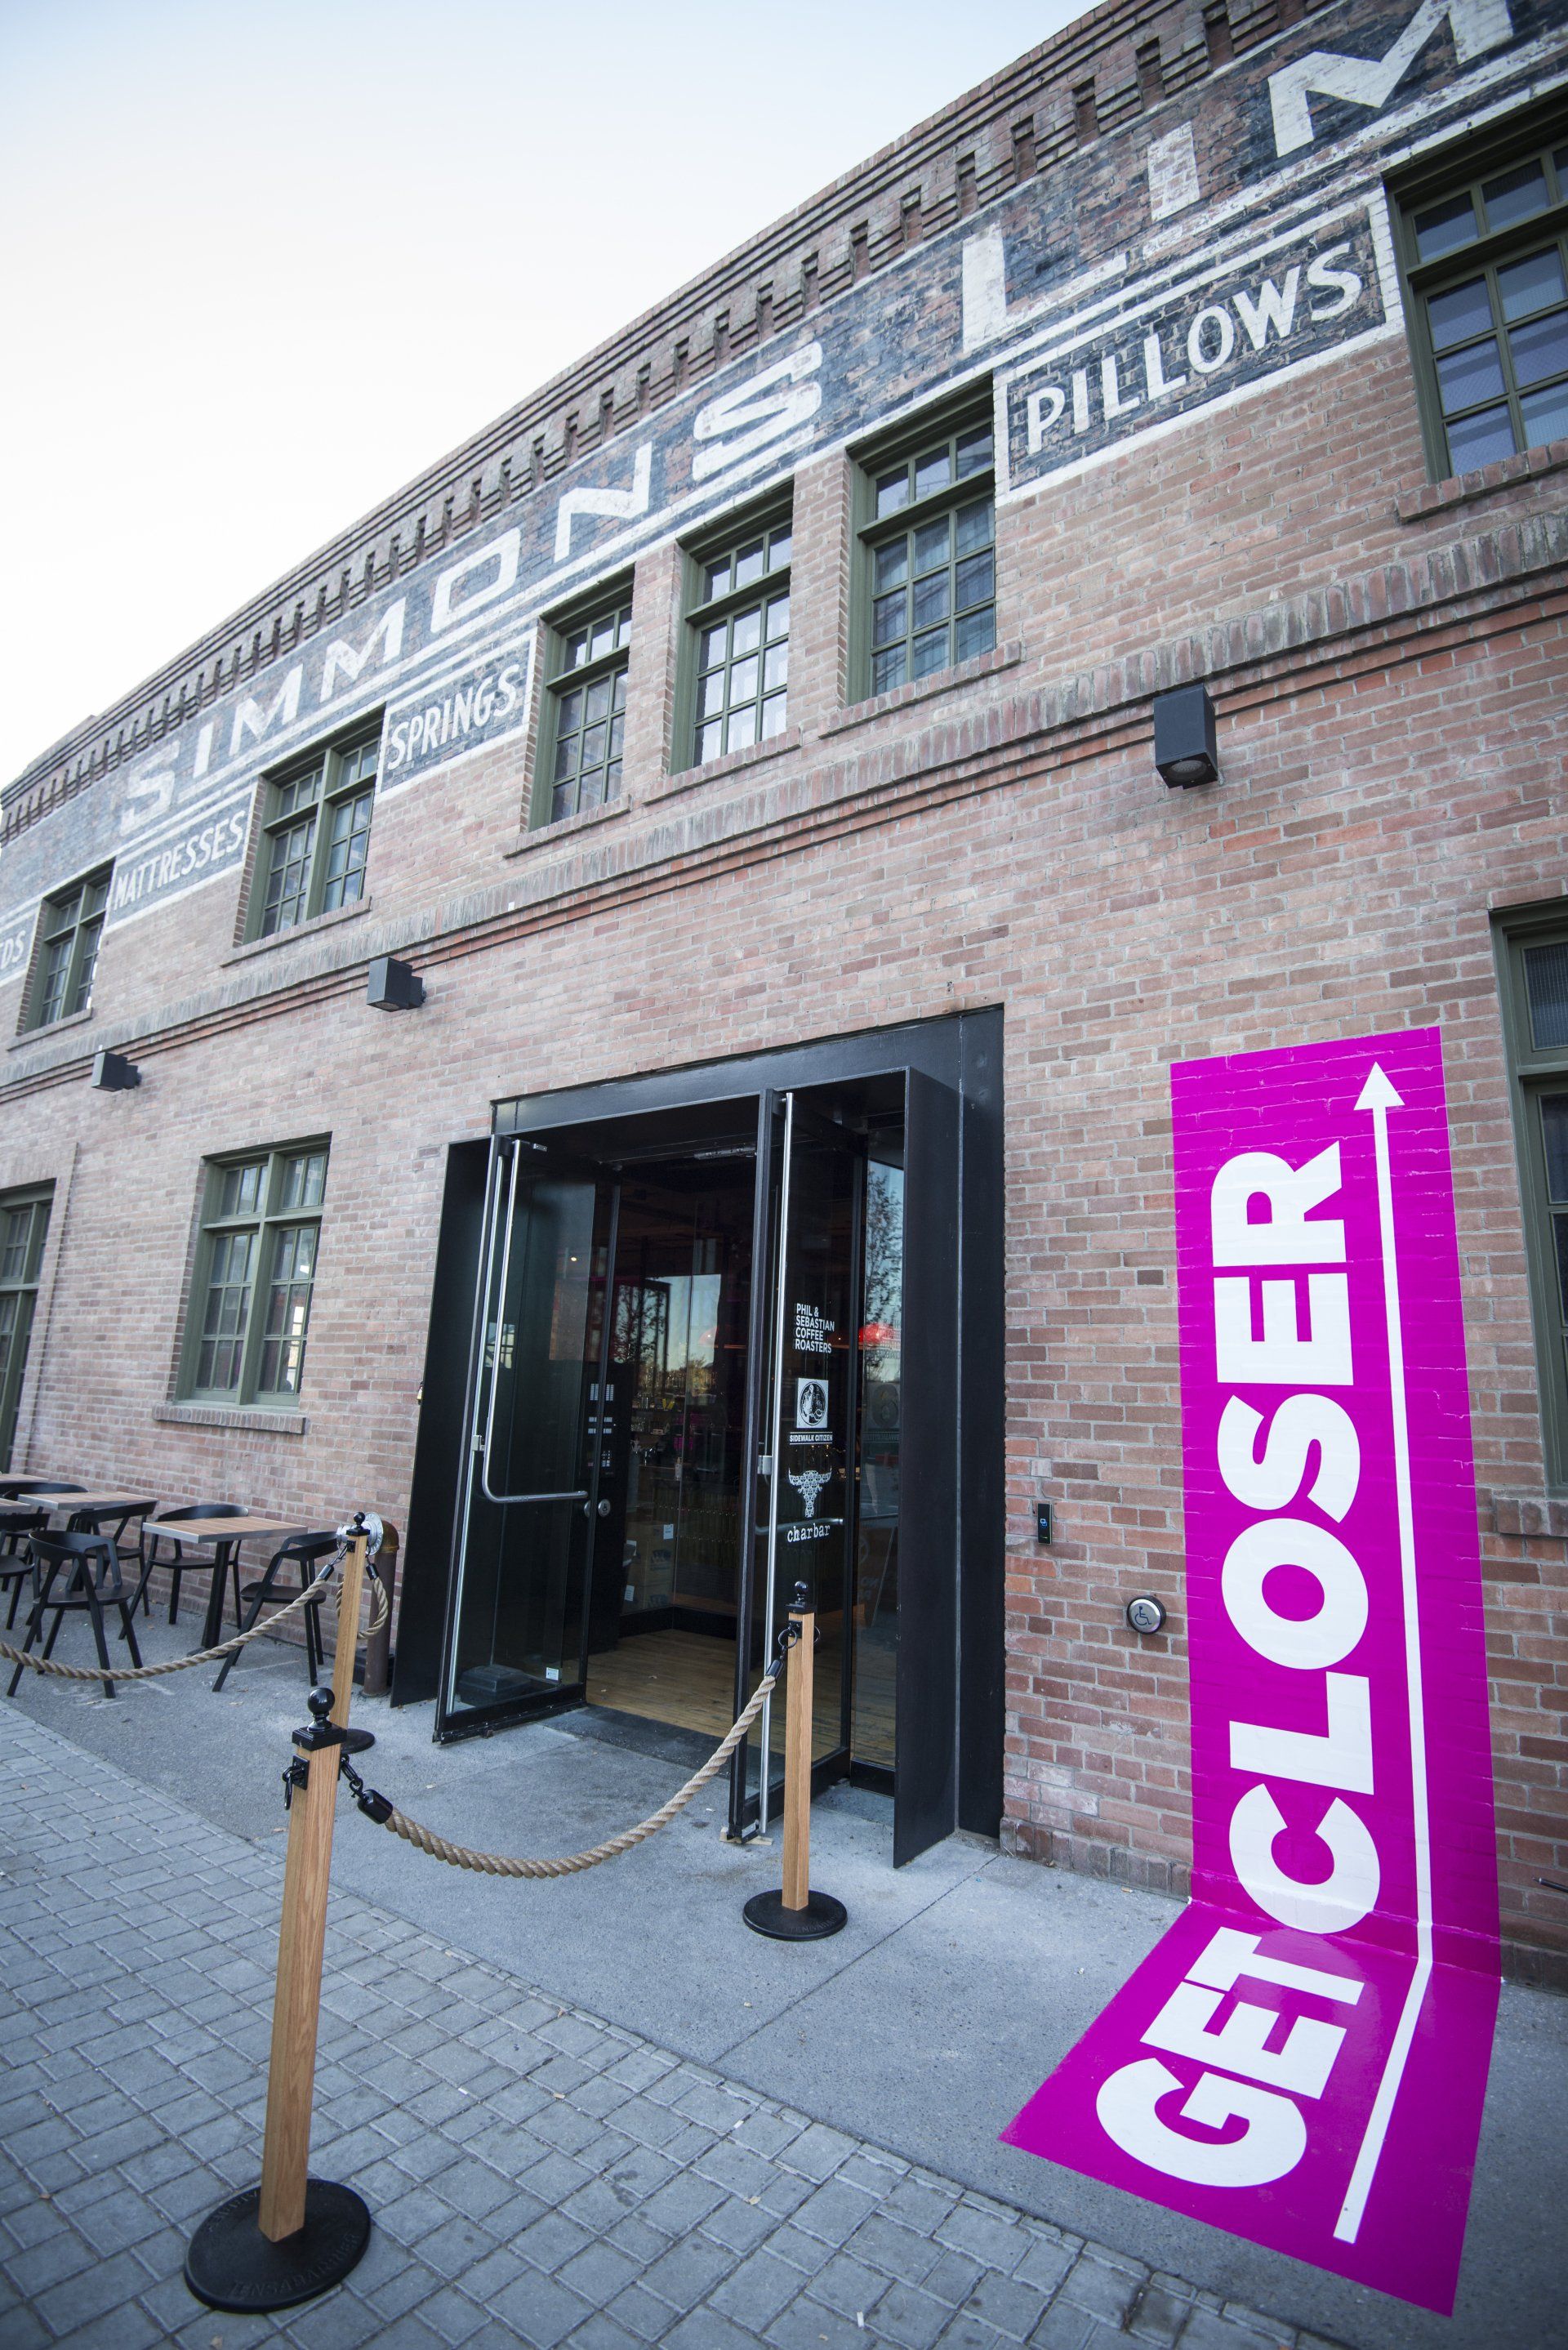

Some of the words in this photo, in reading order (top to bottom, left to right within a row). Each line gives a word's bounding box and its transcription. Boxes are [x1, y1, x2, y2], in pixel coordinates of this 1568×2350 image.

[1027, 243, 1363, 455] PILLOWS
[120, 341, 822, 837] SIMMONS
[387, 663, 520, 770] SPRINGS
[114, 809, 246, 911] MATTRESSES
[0, 930, 26, 970] DS
[795, 1314, 835, 1331] SEBASTIAN
[796, 1303, 813, 1317] PHIL
[814, 1306, 819, 1318] &
[795, 1327, 824, 1341] COFFEE
[795, 1338, 832, 1353] ROASTERS
[790, 1434, 814, 1443] SIDEWALK
[787, 1523, 831, 1543] charbar
[1211, 1140, 1381, 1933] CLOSER
[1096, 1926, 1365, 2187] GET
